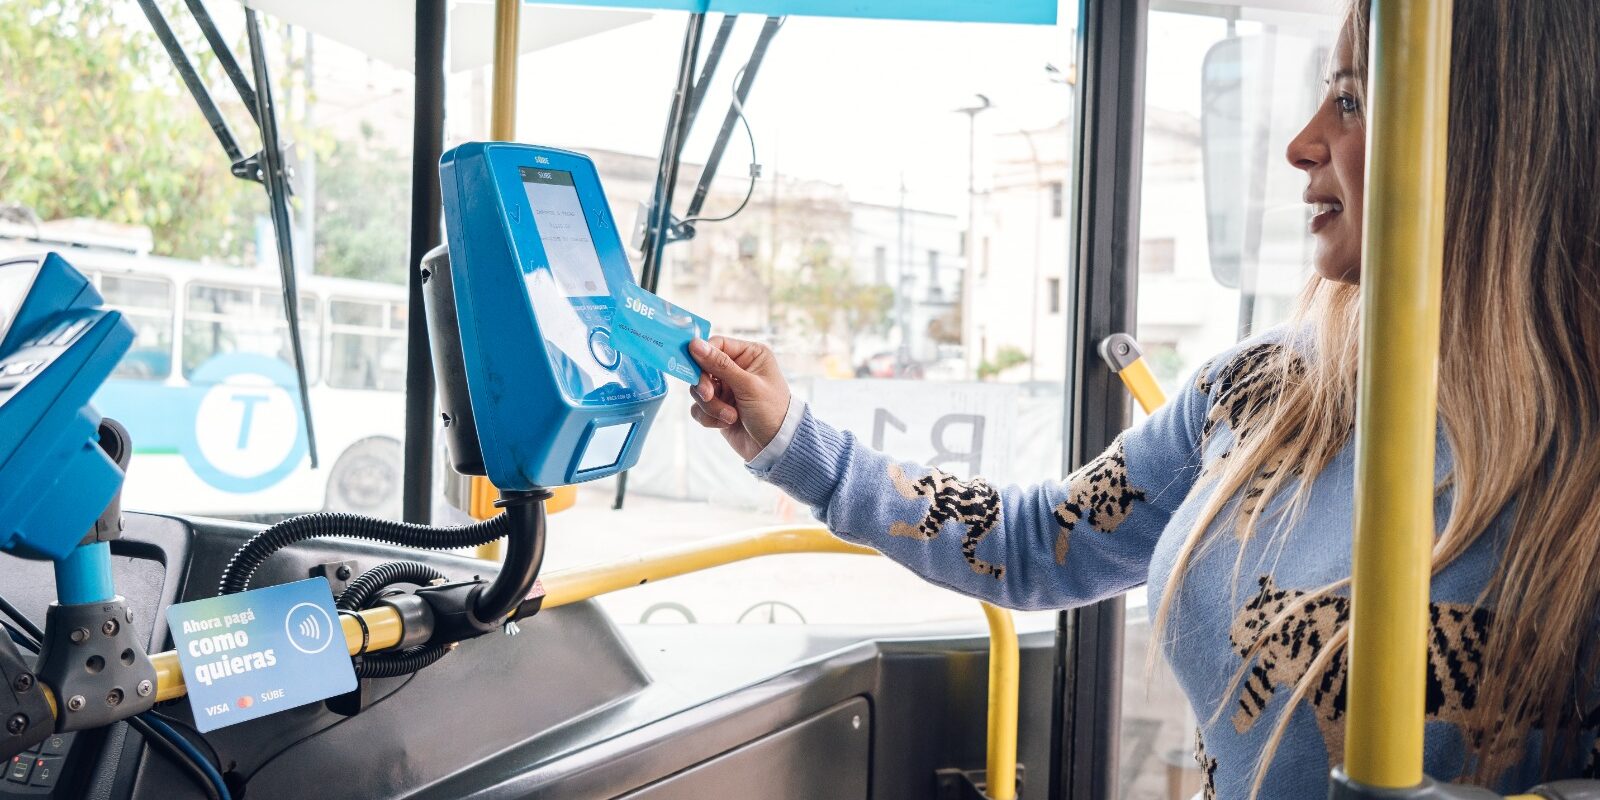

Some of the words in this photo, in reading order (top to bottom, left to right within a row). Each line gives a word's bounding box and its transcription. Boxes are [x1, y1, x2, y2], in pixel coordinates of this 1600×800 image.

[624, 296, 656, 320] SUBE
[231, 394, 270, 449] T
[183, 619, 223, 635] Ahora
[224, 607, 256, 628] pagá
[188, 630, 249, 658] como
[194, 649, 277, 686] quieras
[205, 703, 230, 717] VISA
[260, 688, 286, 703] SUBE
